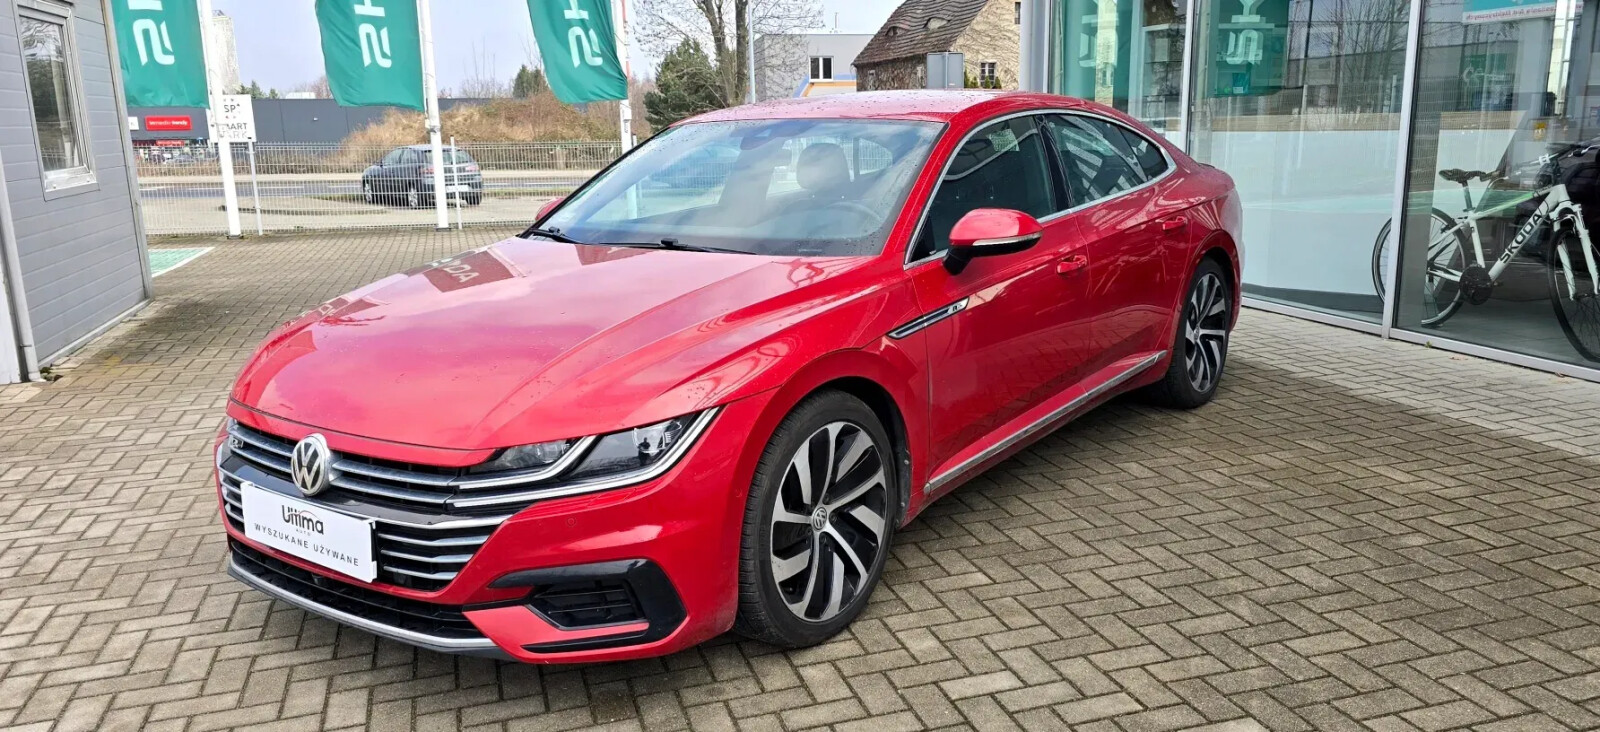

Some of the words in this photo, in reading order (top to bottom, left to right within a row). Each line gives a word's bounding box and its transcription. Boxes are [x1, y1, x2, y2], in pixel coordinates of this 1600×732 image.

[281, 504, 324, 535] Ultima
[254, 522, 309, 549] WYSZUKANE
[313, 542, 359, 567] UŻYWANE
